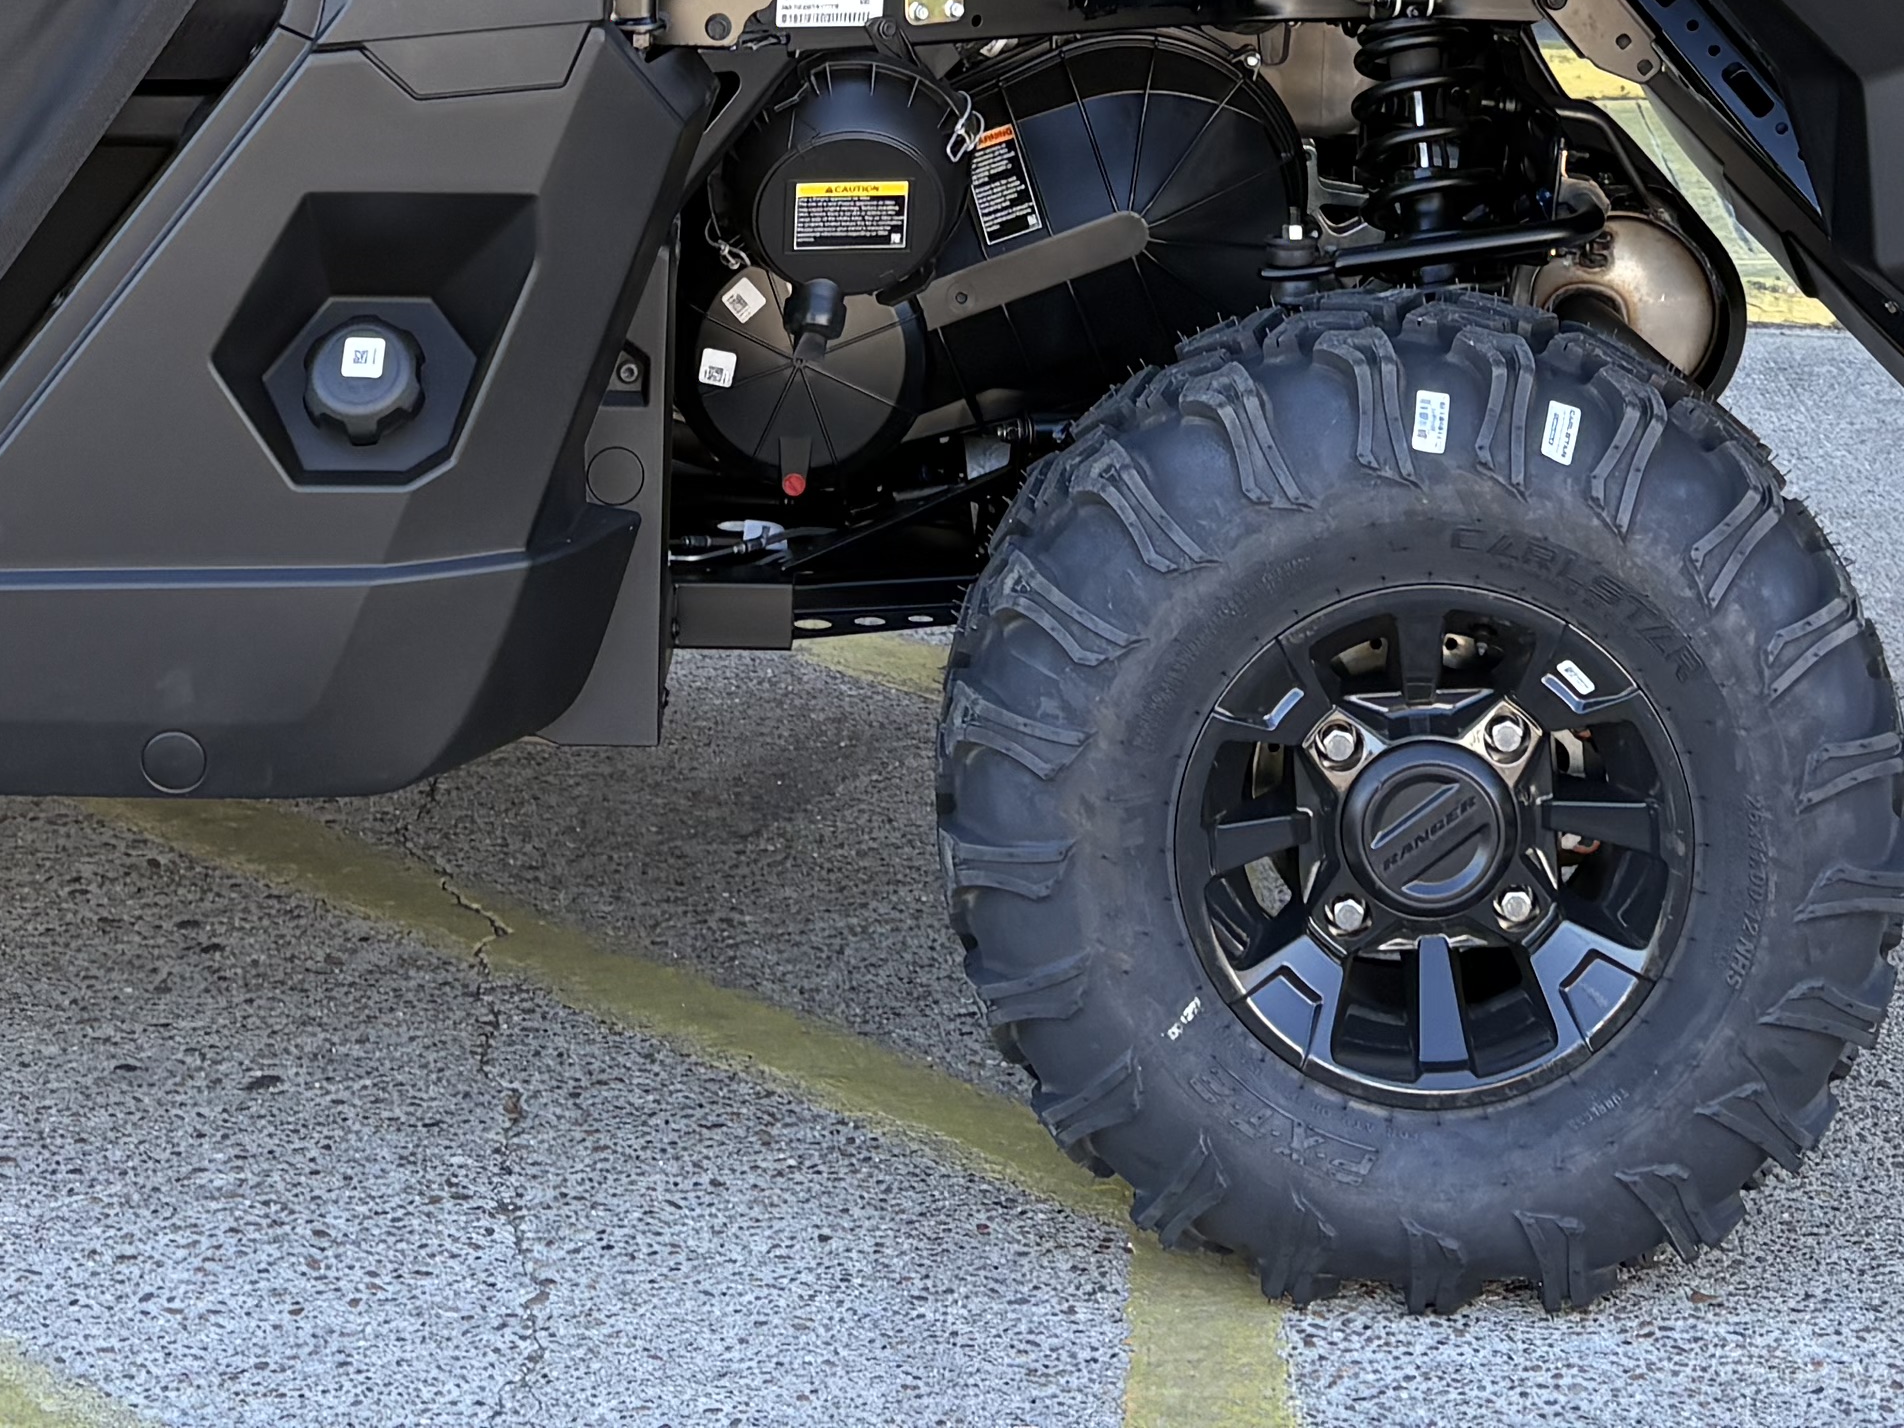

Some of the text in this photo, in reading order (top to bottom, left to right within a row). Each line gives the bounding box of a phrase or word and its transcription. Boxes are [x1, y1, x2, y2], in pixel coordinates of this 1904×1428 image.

[834, 185, 880, 194] CAUTION
[1450, 523, 1707, 685] CARLSTAR
[1382, 795, 1478, 872] RANGER
